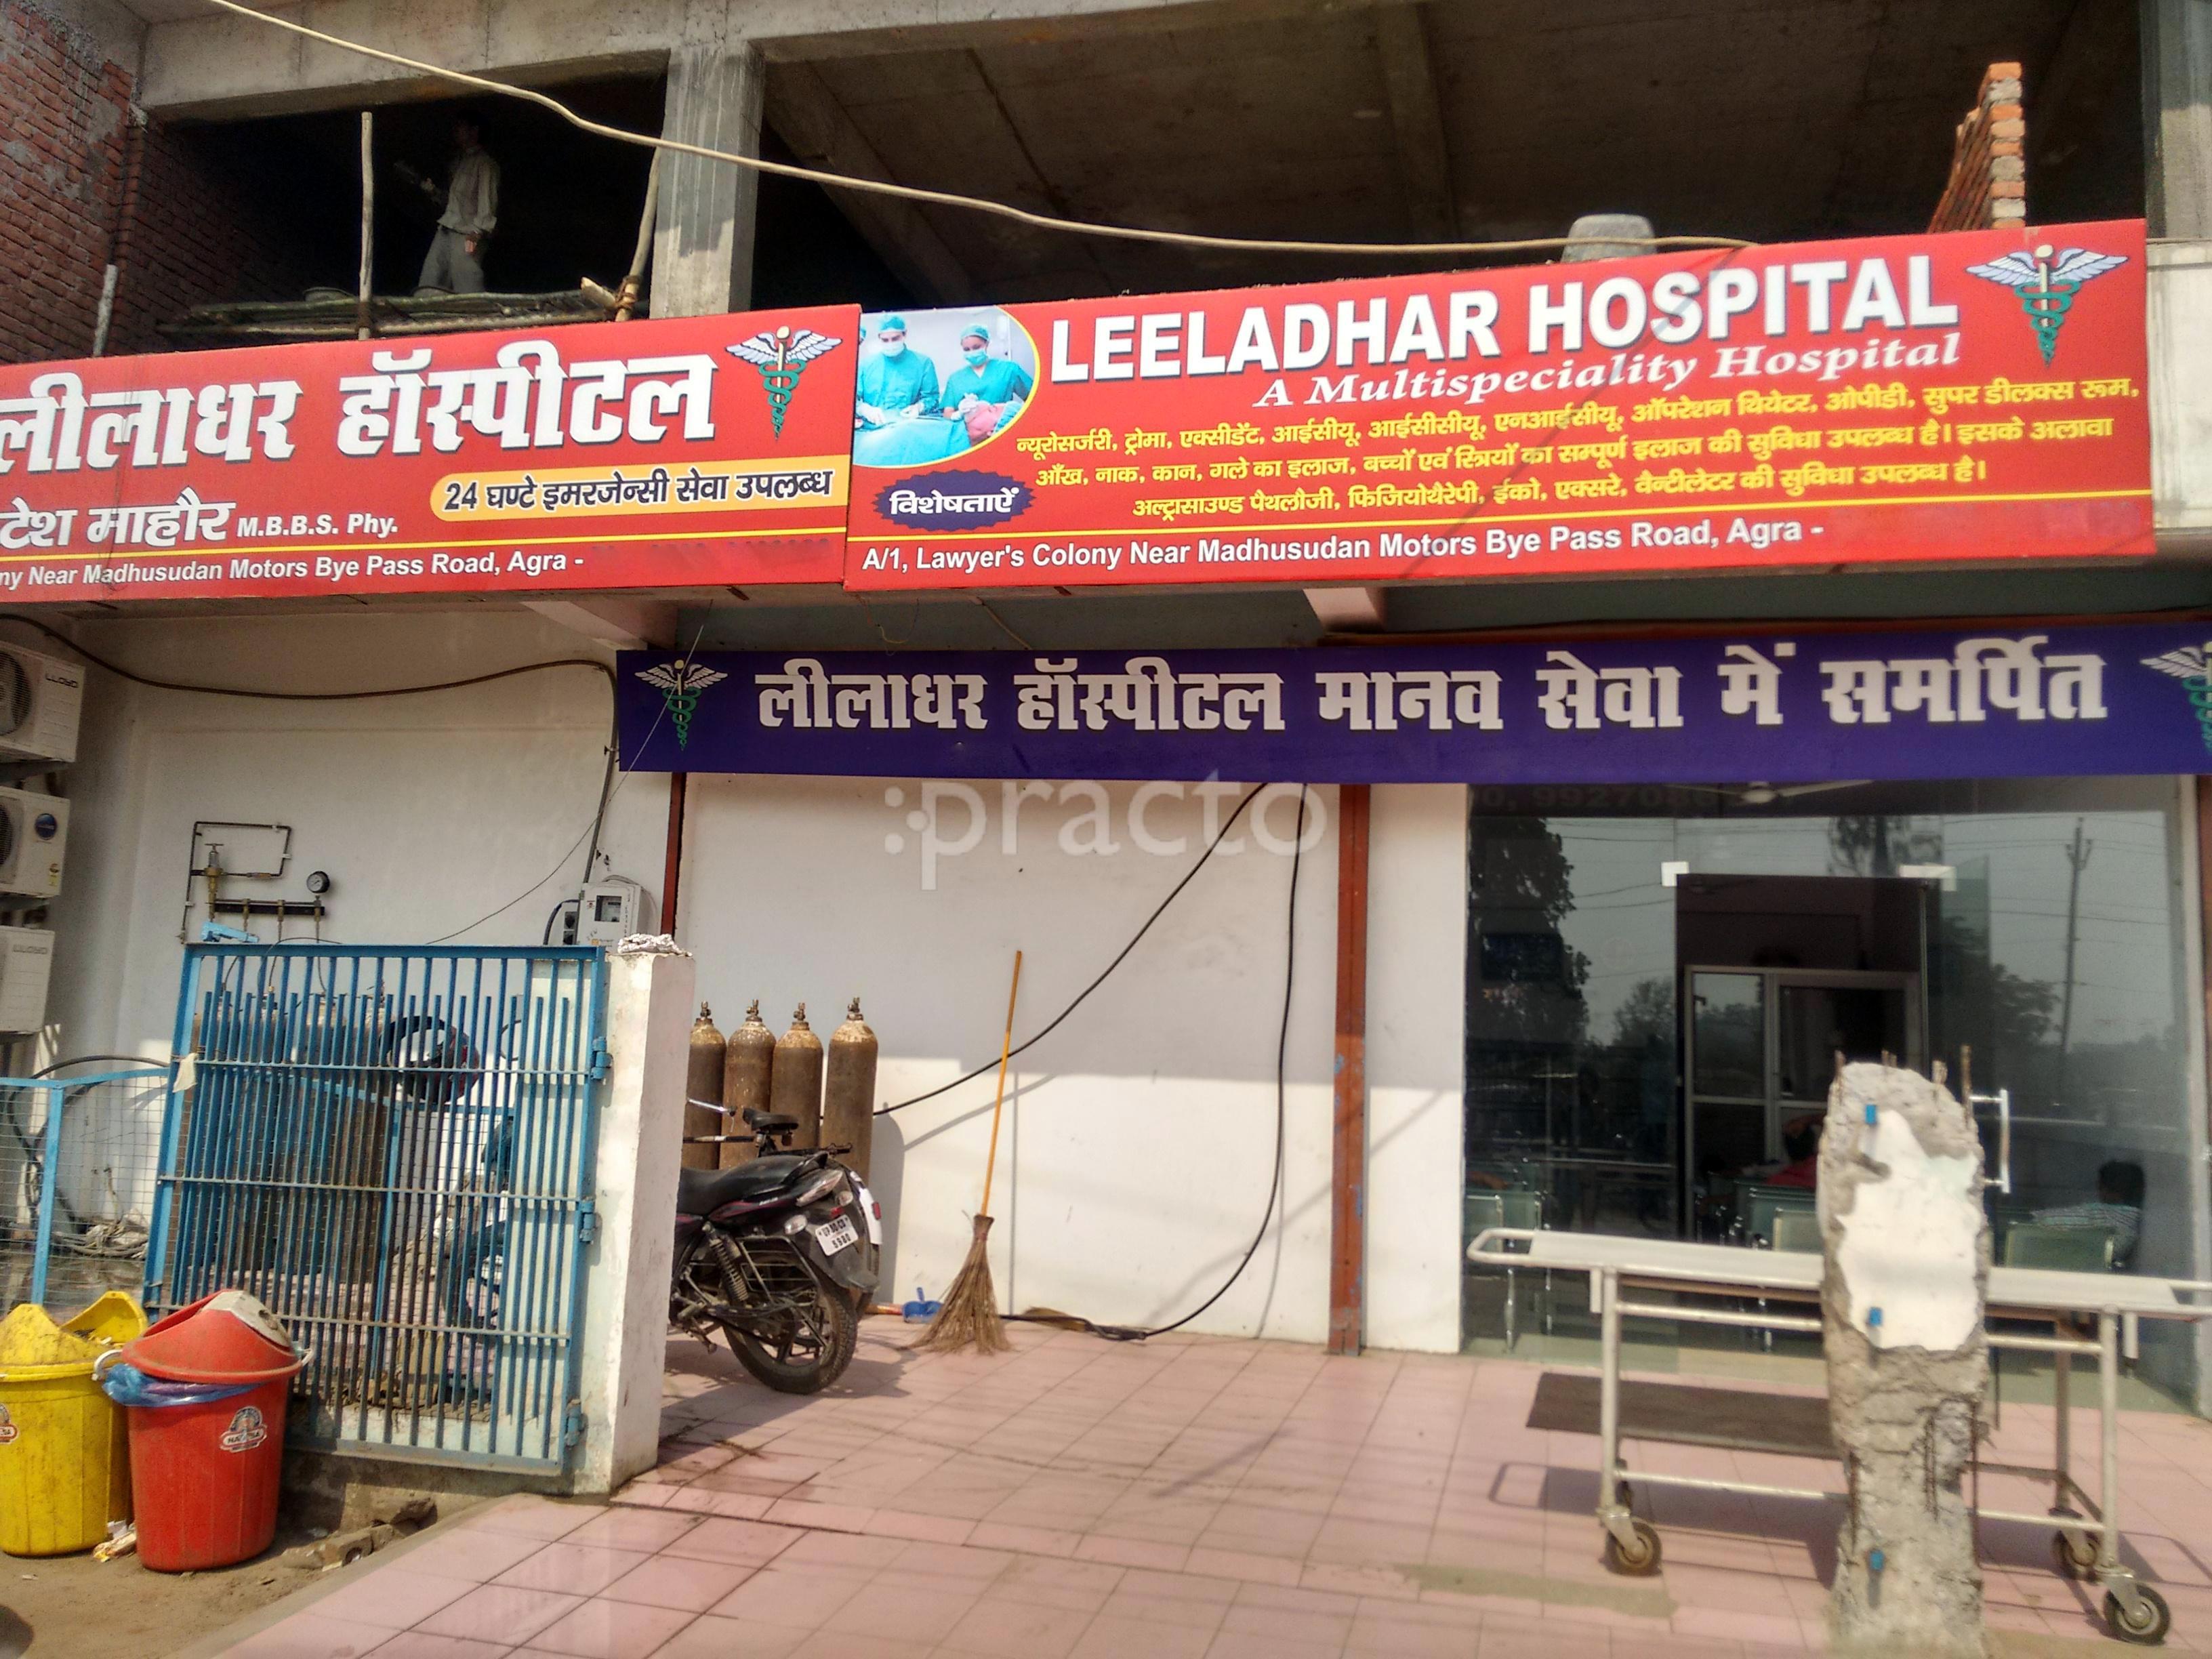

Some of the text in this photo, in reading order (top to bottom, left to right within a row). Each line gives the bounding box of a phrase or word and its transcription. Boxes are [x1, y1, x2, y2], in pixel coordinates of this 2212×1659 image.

[1051, 255, 1957, 382] LEELADHAR HOSPITAL
[1252, 332, 1960, 407] A Multispeciality Hospital
[0, 340, 718, 473] लीलाधर हॉस्पीटल
[1271, 417, 1361, 447] आईसीयू,
[1922, 386, 1981, 414] सुपर
[1095, 466, 1145, 484] नाक,
[1152, 464, 1203, 482] कान,
[1209, 456, 1250, 480] गले
[1253, 461, 1282, 477] का
[1287, 457, 1356, 478] इलाज,
[1418, 446, 1453, 471] एवं
[1521, 445, 1553, 464] का
[1633, 437, 1703, 461] इलाज
[1708, 428, 1743, 453] की
[1747, 425, 1822, 461] सुविधा
[1826, 426, 1914, 448] उपलब्ध
[1957, 415, 2025, 445] इसके
[2030, 418, 2114, 440] अलावा
[1740, 463, 1776, 489] की
[1778, 461, 1856, 497] सुविधा
[1860, 462, 1949, 484] उपलब्ध
[86, 486, 237, 547] माहौर
[444, 467, 834, 510] 24 घण्टे इमरजेन्सी सेवा उपलब्ध
[237, 512, 398, 538] M.B.B.S. Phy.
[862, 548, 907, 573] A/1,
[917, 545, 1025, 574] Lawyer's
[1032, 541, 1122, 571] Colony
[1129, 541, 1191, 565] Near
[1198, 535, 1370, 562] Madhusudan
[1380, 532, 1475, 557] Motors
[1486, 527, 1540, 560] Bye
[1550, 525, 1621, 552] Pass
[1631, 519, 1719, 548] Road,
[1726, 518, 1802, 549] Agra
[28, 566, 79, 585] Near
[83, 561, 222, 585] Madhusudan
[230, 558, 308, 579] Motors
[314, 556, 360, 581] Bye
[366, 554, 424, 576] Pass
[431, 552, 501, 575] Road,
[507, 550, 567, 576] Agra
[754, 634, 2108, 731] लीलाधर हॉस्पीटल मानव सेवा में समर्पित
